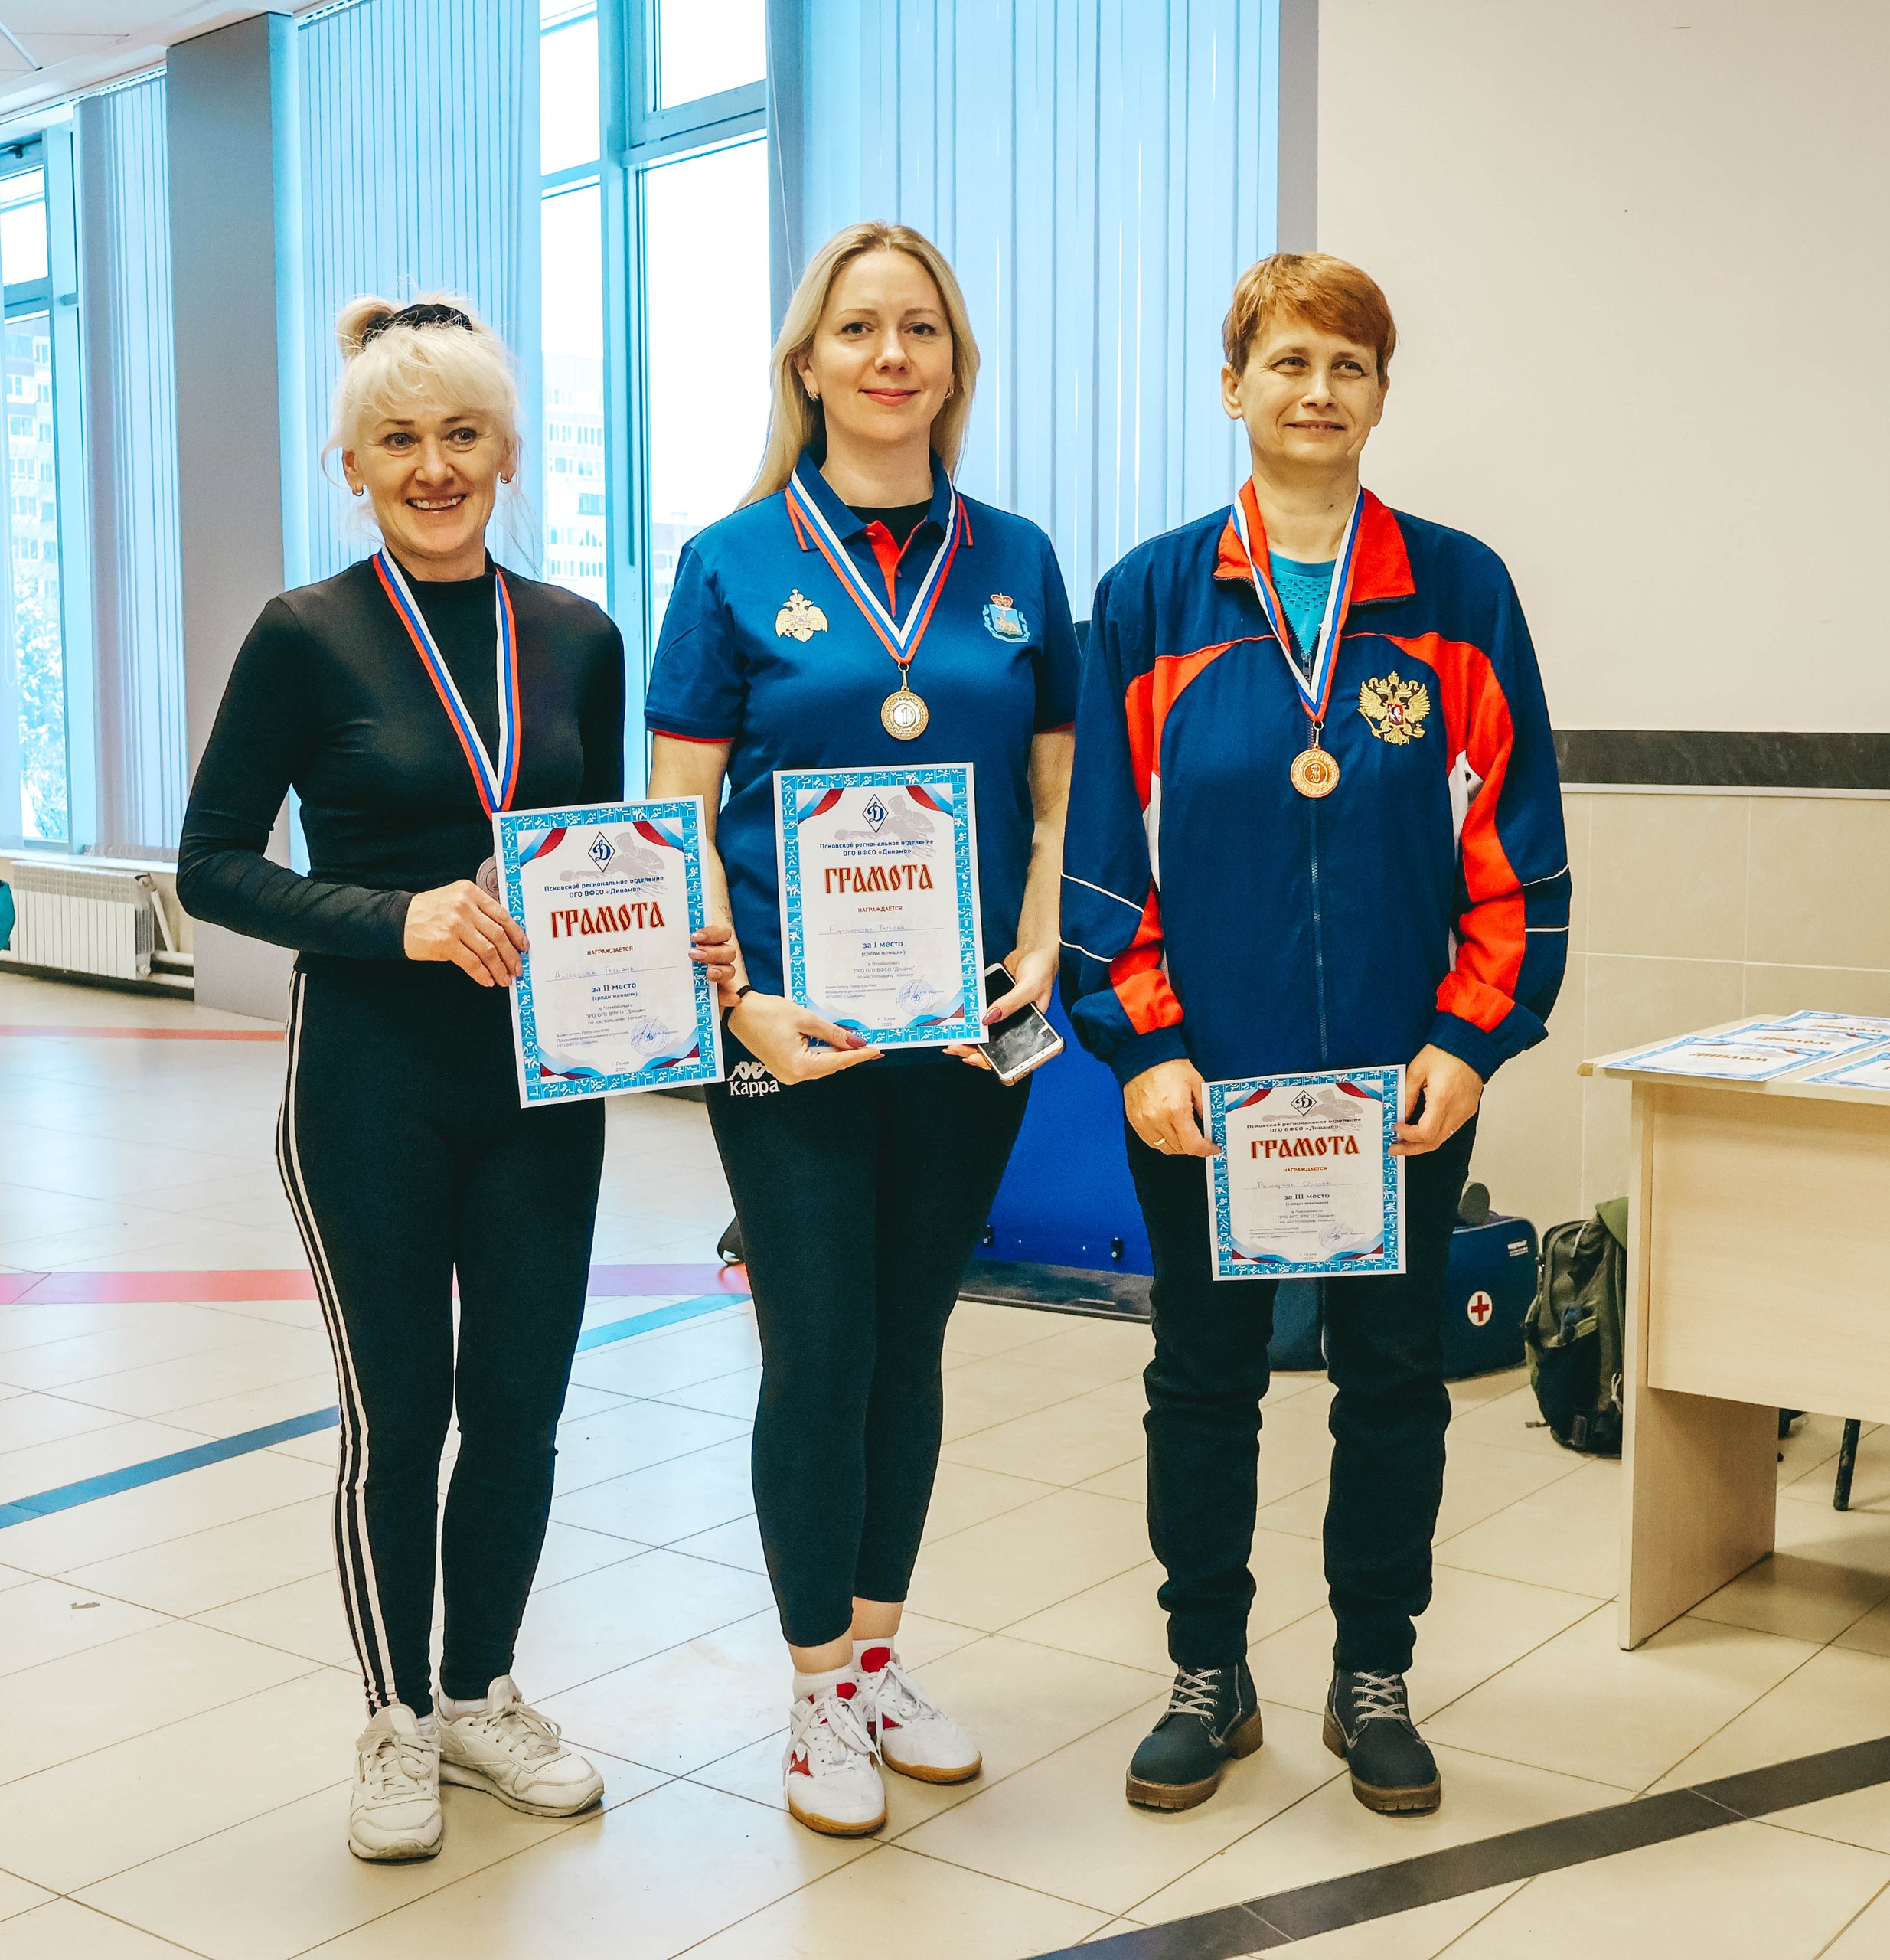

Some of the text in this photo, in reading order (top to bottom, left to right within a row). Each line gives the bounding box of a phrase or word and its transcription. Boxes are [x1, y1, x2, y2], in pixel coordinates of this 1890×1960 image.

[855, 841, 899, 849] региональное
[544, 884, 579, 892] Псковское
[582, 879, 628, 890] региональное
[824, 864, 935, 894] ГРАМОТА
[606, 887, 641, 896] «Динамо»
[550, 901, 666, 939] ГРАМОТА
[586, 946, 633, 956] НАГРАЖДАЕТСЯ
[612, 982, 636, 991] место
[729, 1080, 780, 1098] Kappa
[1250, 1135, 1360, 1159] ГРАМОТА
